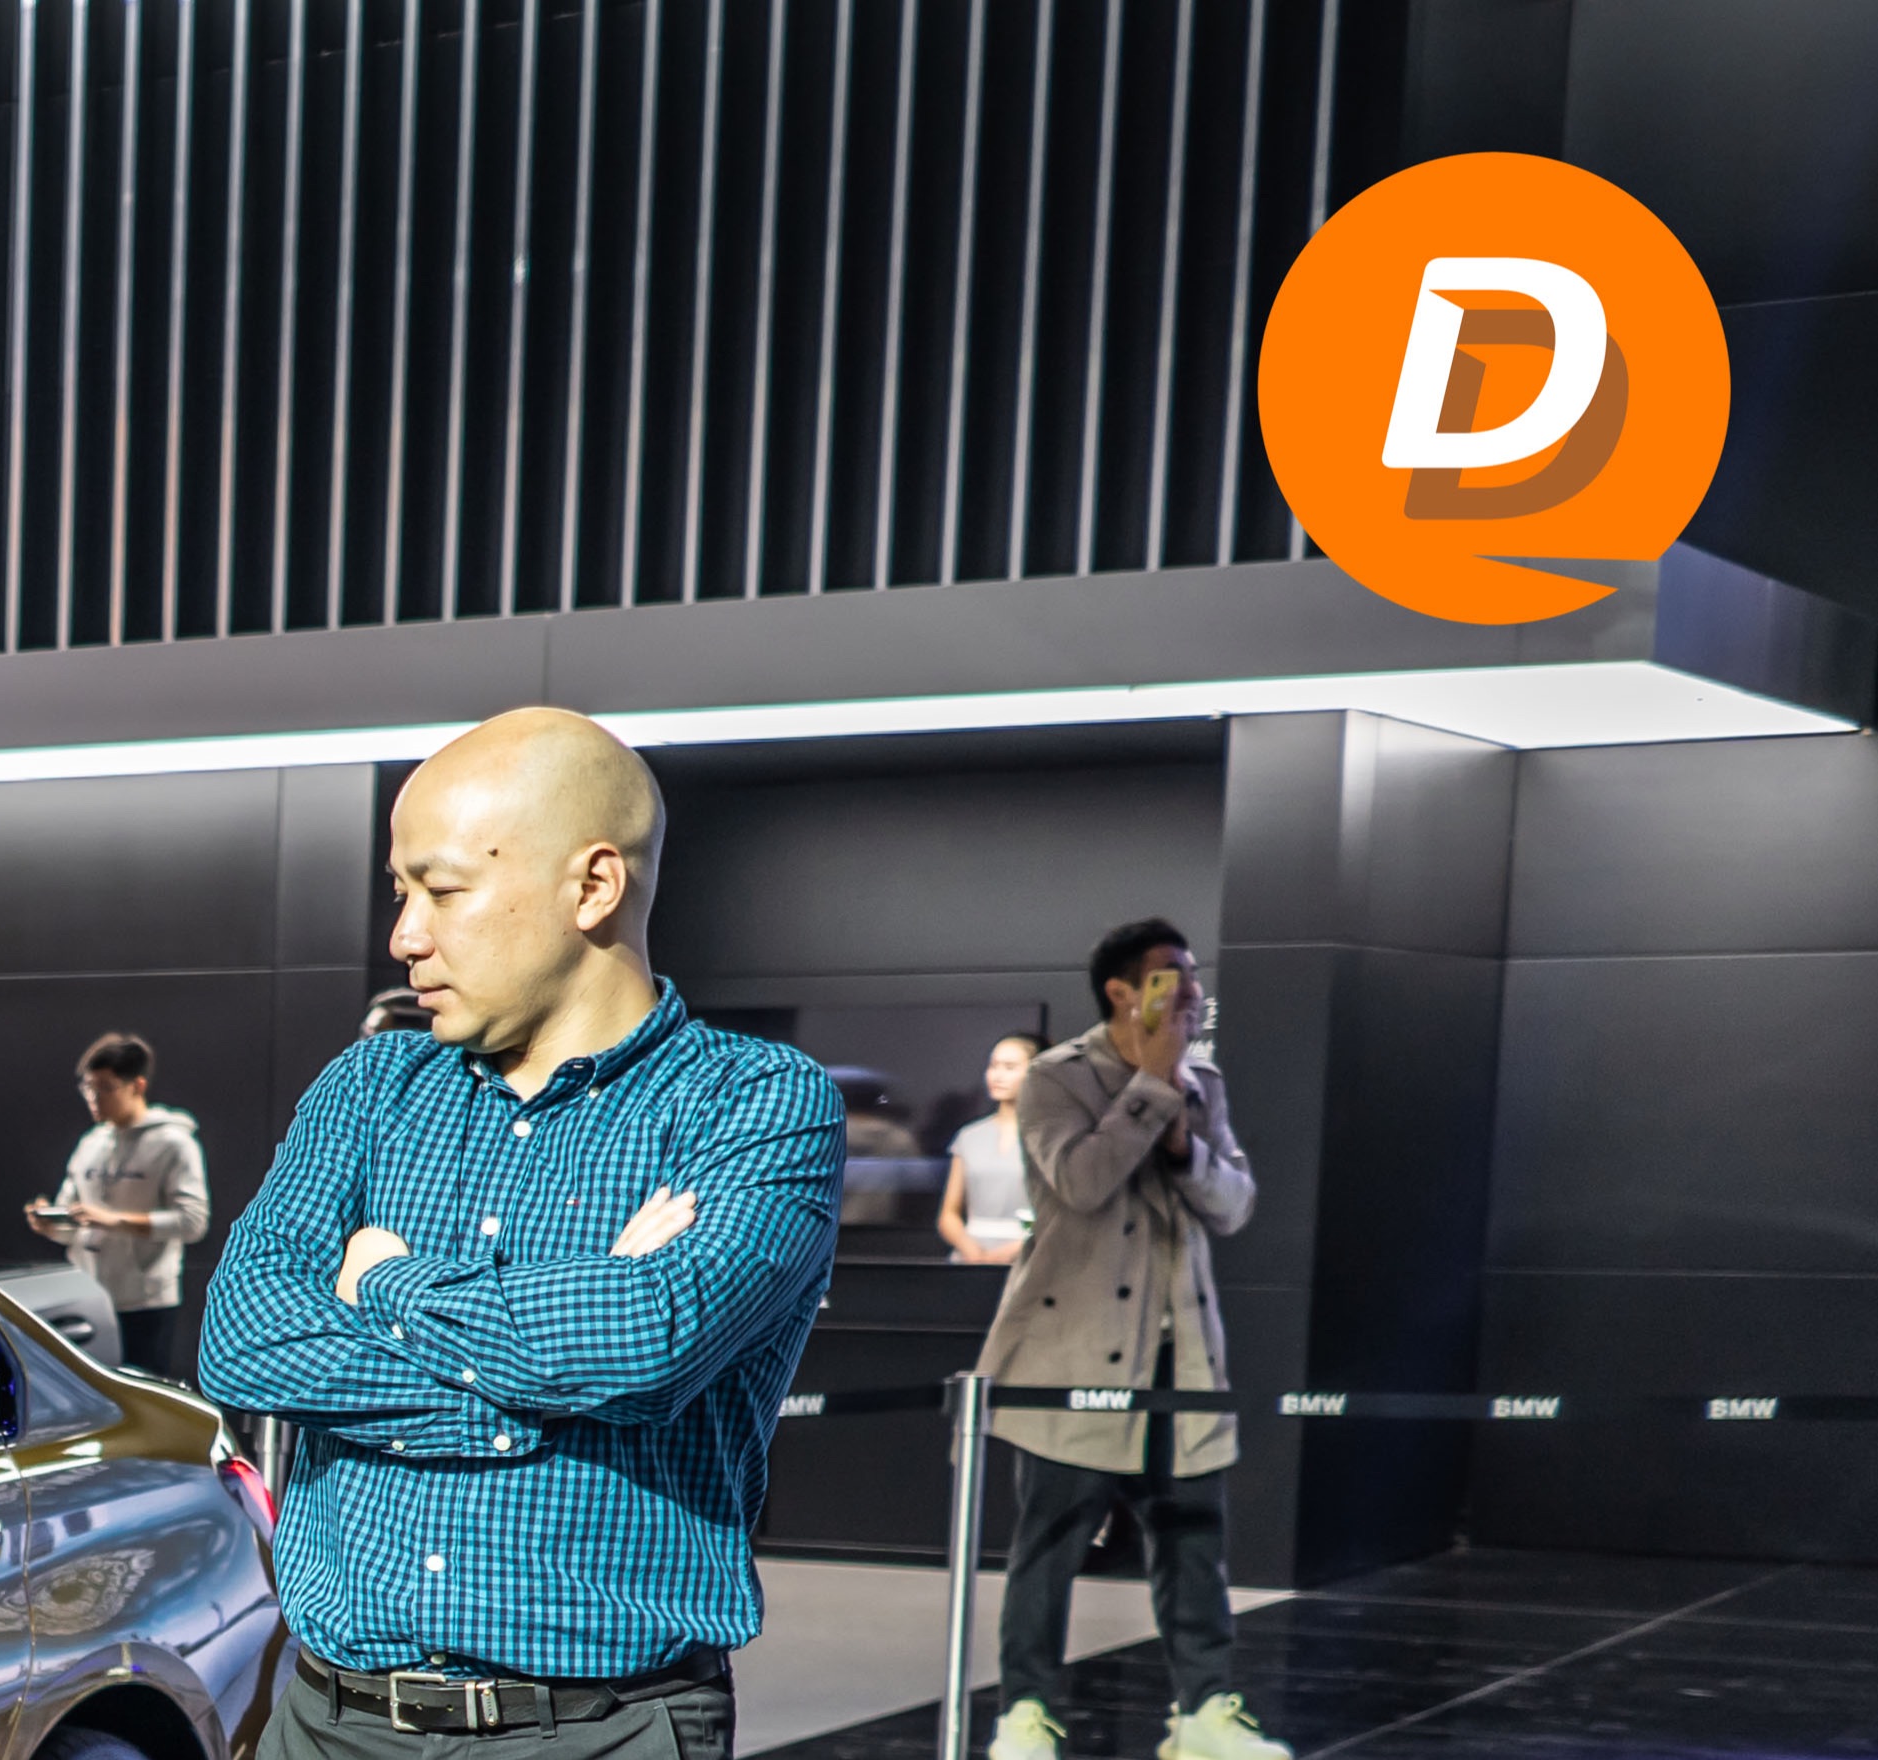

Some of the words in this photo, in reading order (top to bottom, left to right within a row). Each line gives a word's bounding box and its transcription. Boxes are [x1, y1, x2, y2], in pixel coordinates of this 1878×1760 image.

[1068, 1390, 1133, 1410] BMW
[1280, 1394, 1346, 1415] BMW
[1491, 1397, 1561, 1418] BMW
[1706, 1398, 1778, 1419] BMW
